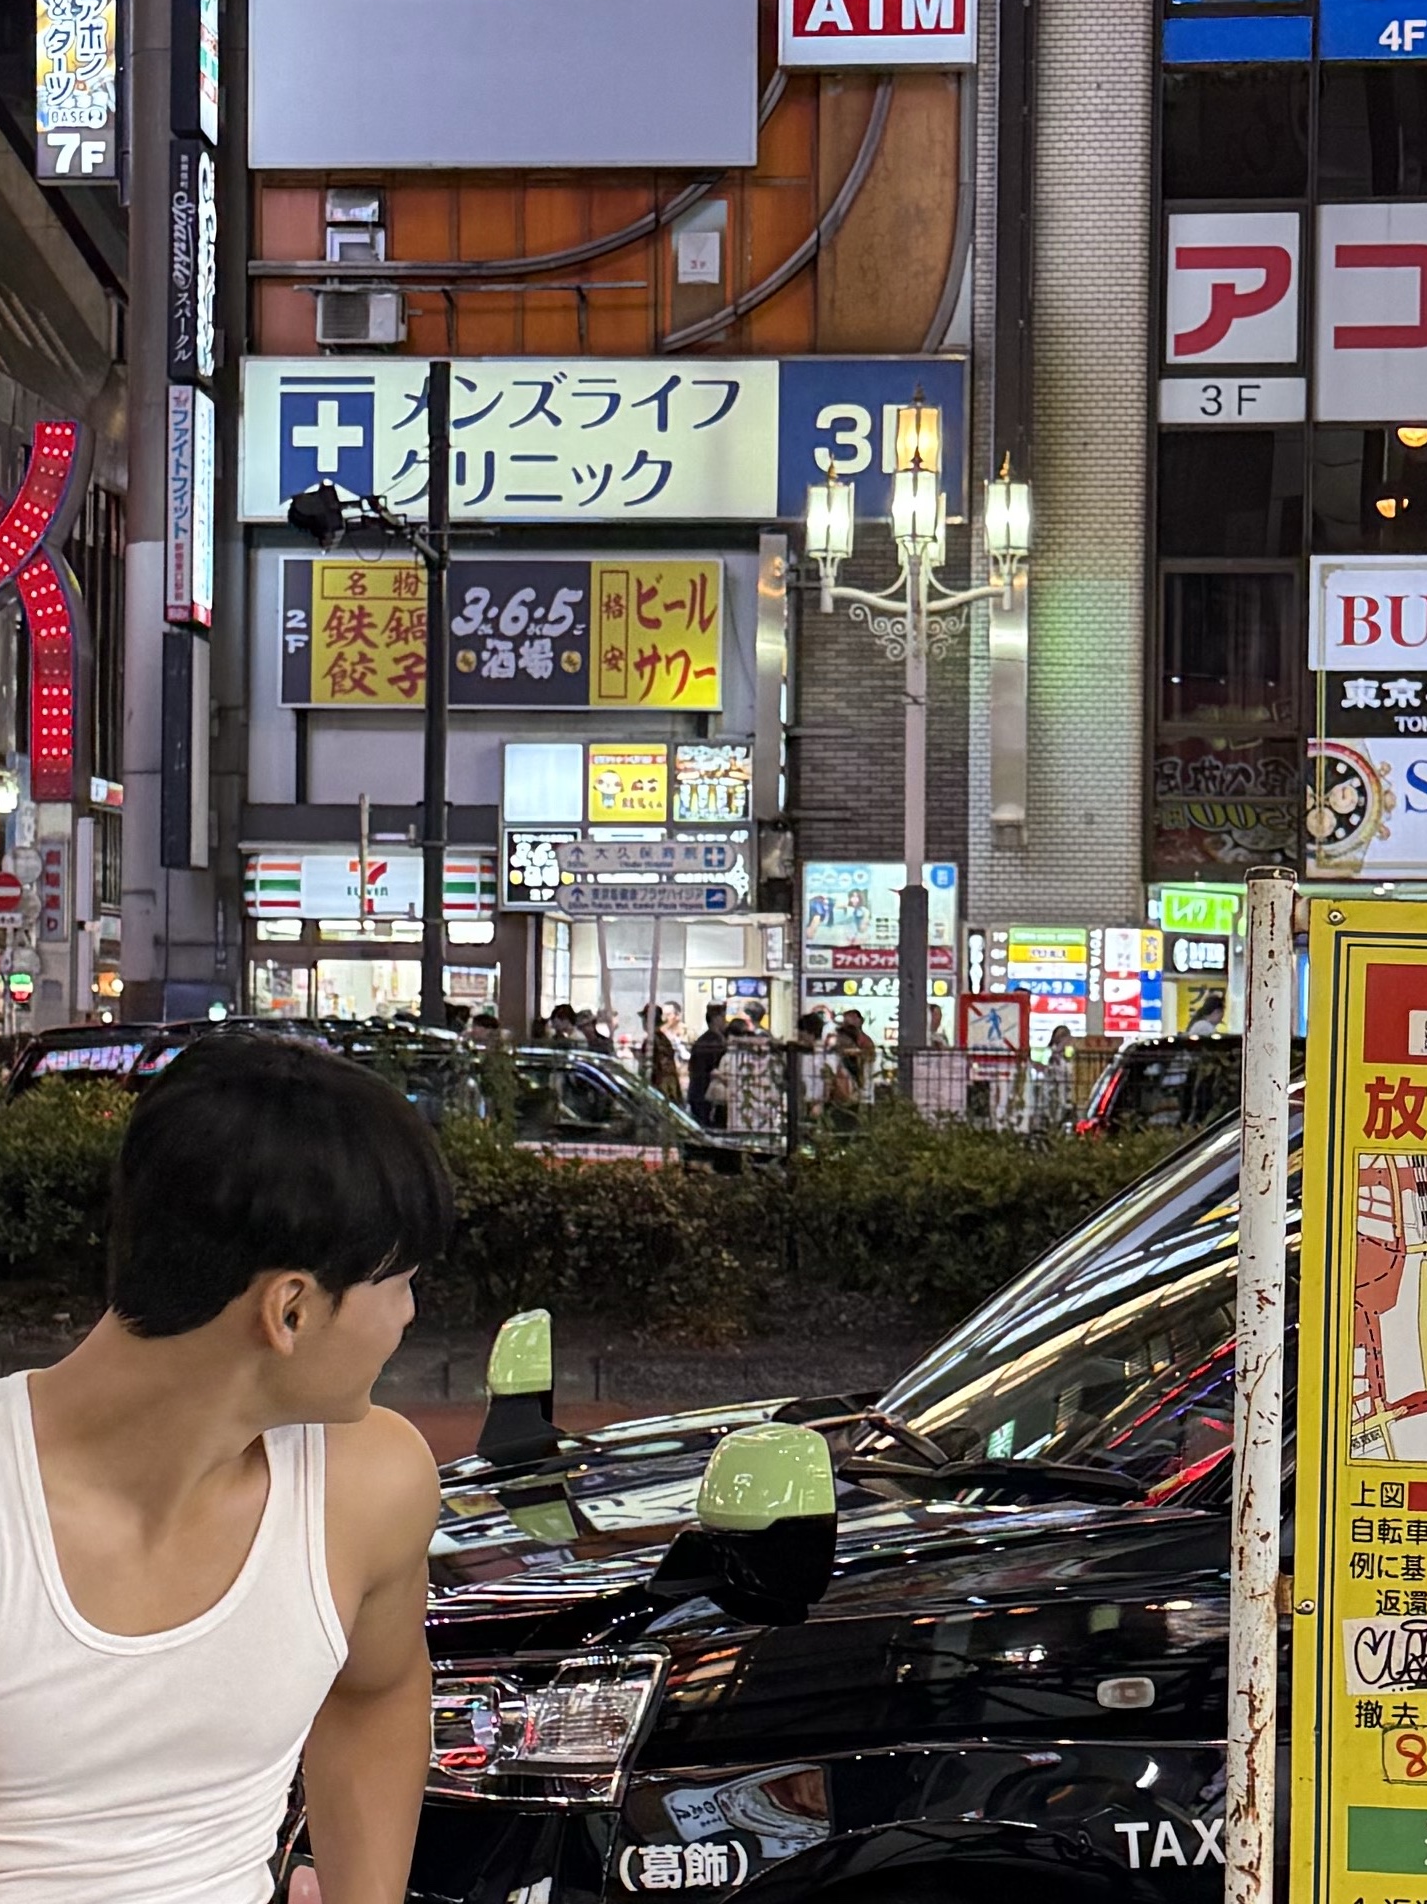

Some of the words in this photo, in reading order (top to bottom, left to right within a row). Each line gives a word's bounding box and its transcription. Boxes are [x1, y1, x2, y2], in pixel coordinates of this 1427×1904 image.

[1377, 19, 1427, 52] 4F
[46, 131, 107, 175] 7F
[389, 371, 743, 431] メンズライフ
[1199, 384, 1262, 417] 3F
[390, 447, 674, 508] クリニック
[344, 569, 421, 597] 名物
[635, 571, 719, 635] ビール
[284, 608, 310, 655] 2F
[321, 603, 427, 651] 鉄鍋
[603, 592, 626, 673] 格安
[321, 650, 427, 698] 餃子
[480, 638, 554, 681] 酒場
[632, 644, 719, 703] サワー
[1350, 1480, 1405, 1510] 上図
